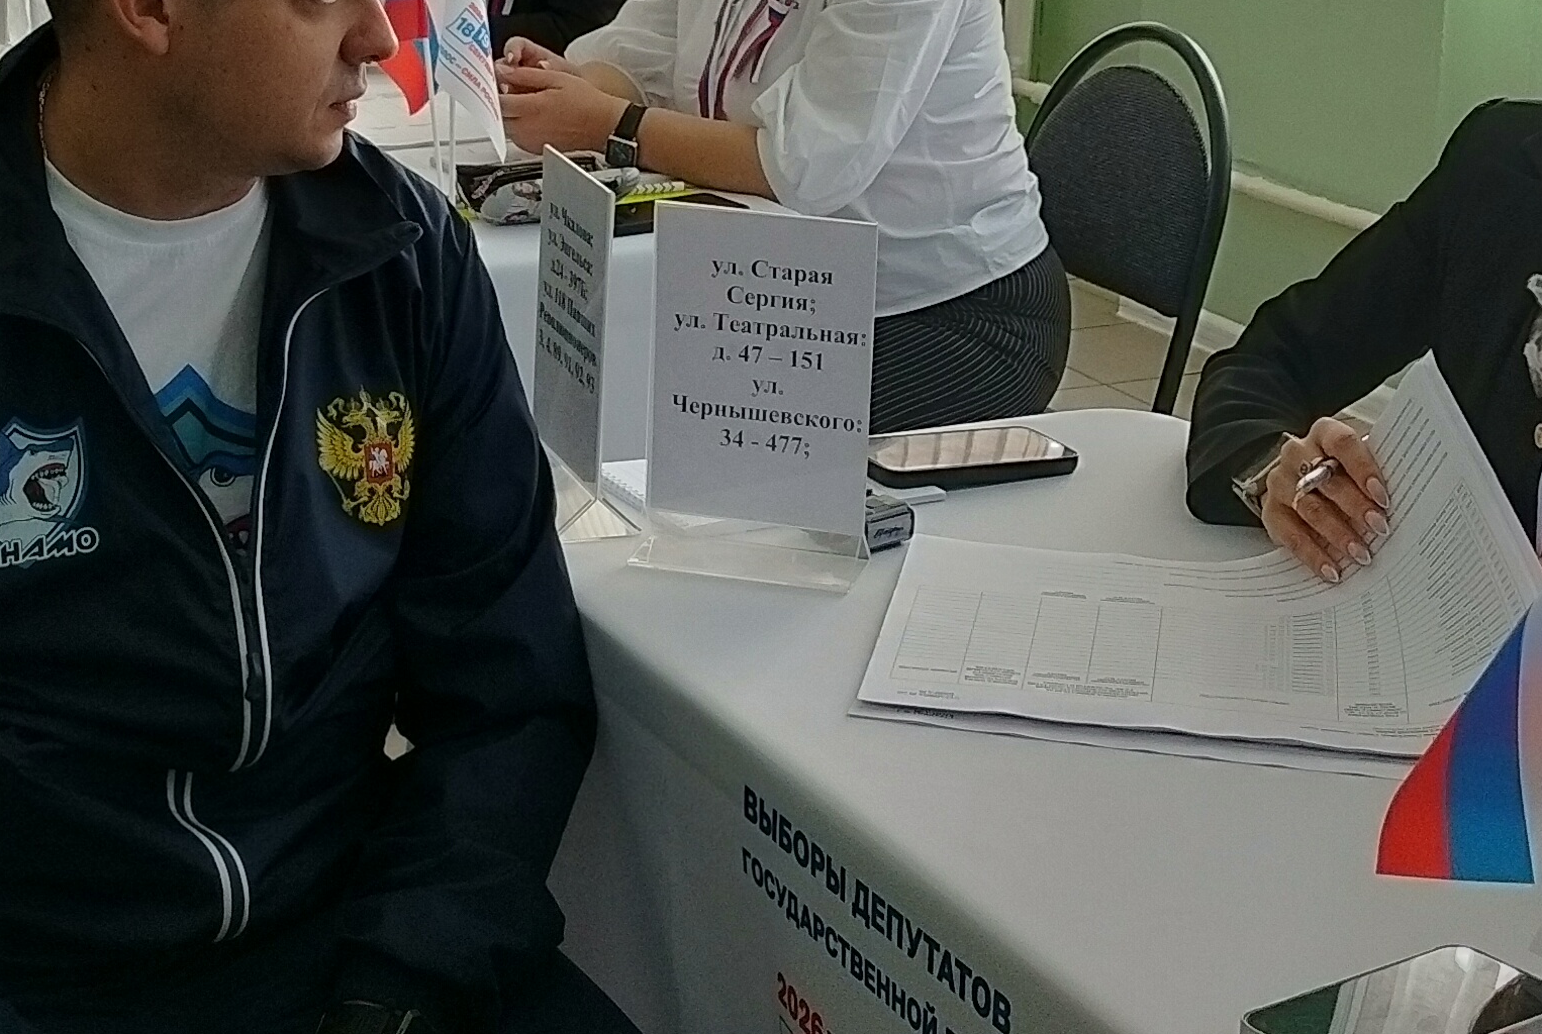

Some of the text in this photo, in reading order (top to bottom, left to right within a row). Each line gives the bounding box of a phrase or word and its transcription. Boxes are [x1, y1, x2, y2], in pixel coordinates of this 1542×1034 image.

[456, 17, 475, 38] 18
[461, 67, 482, 90] СИЛА
[711, 259, 833, 287] ул. Старая
[726, 285, 816, 316] Сергия;
[674, 312, 867, 347] ул. Театральная:
[711, 345, 731, 361] д.
[738, 344, 763, 364] 47
[790, 349, 824, 371] 151
[751, 379, 784, 397] ул.
[672, 393, 863, 433] Чернышевского:
[719, 428, 745, 448] 34
[765, 433, 811, 459] 477;
[743, 784, 1014, 1034] ВЫБОРЫ ДЕПУТАТОВ
[741, 846, 938, 1034] ГОСУДАРСТВЕННОЙ
